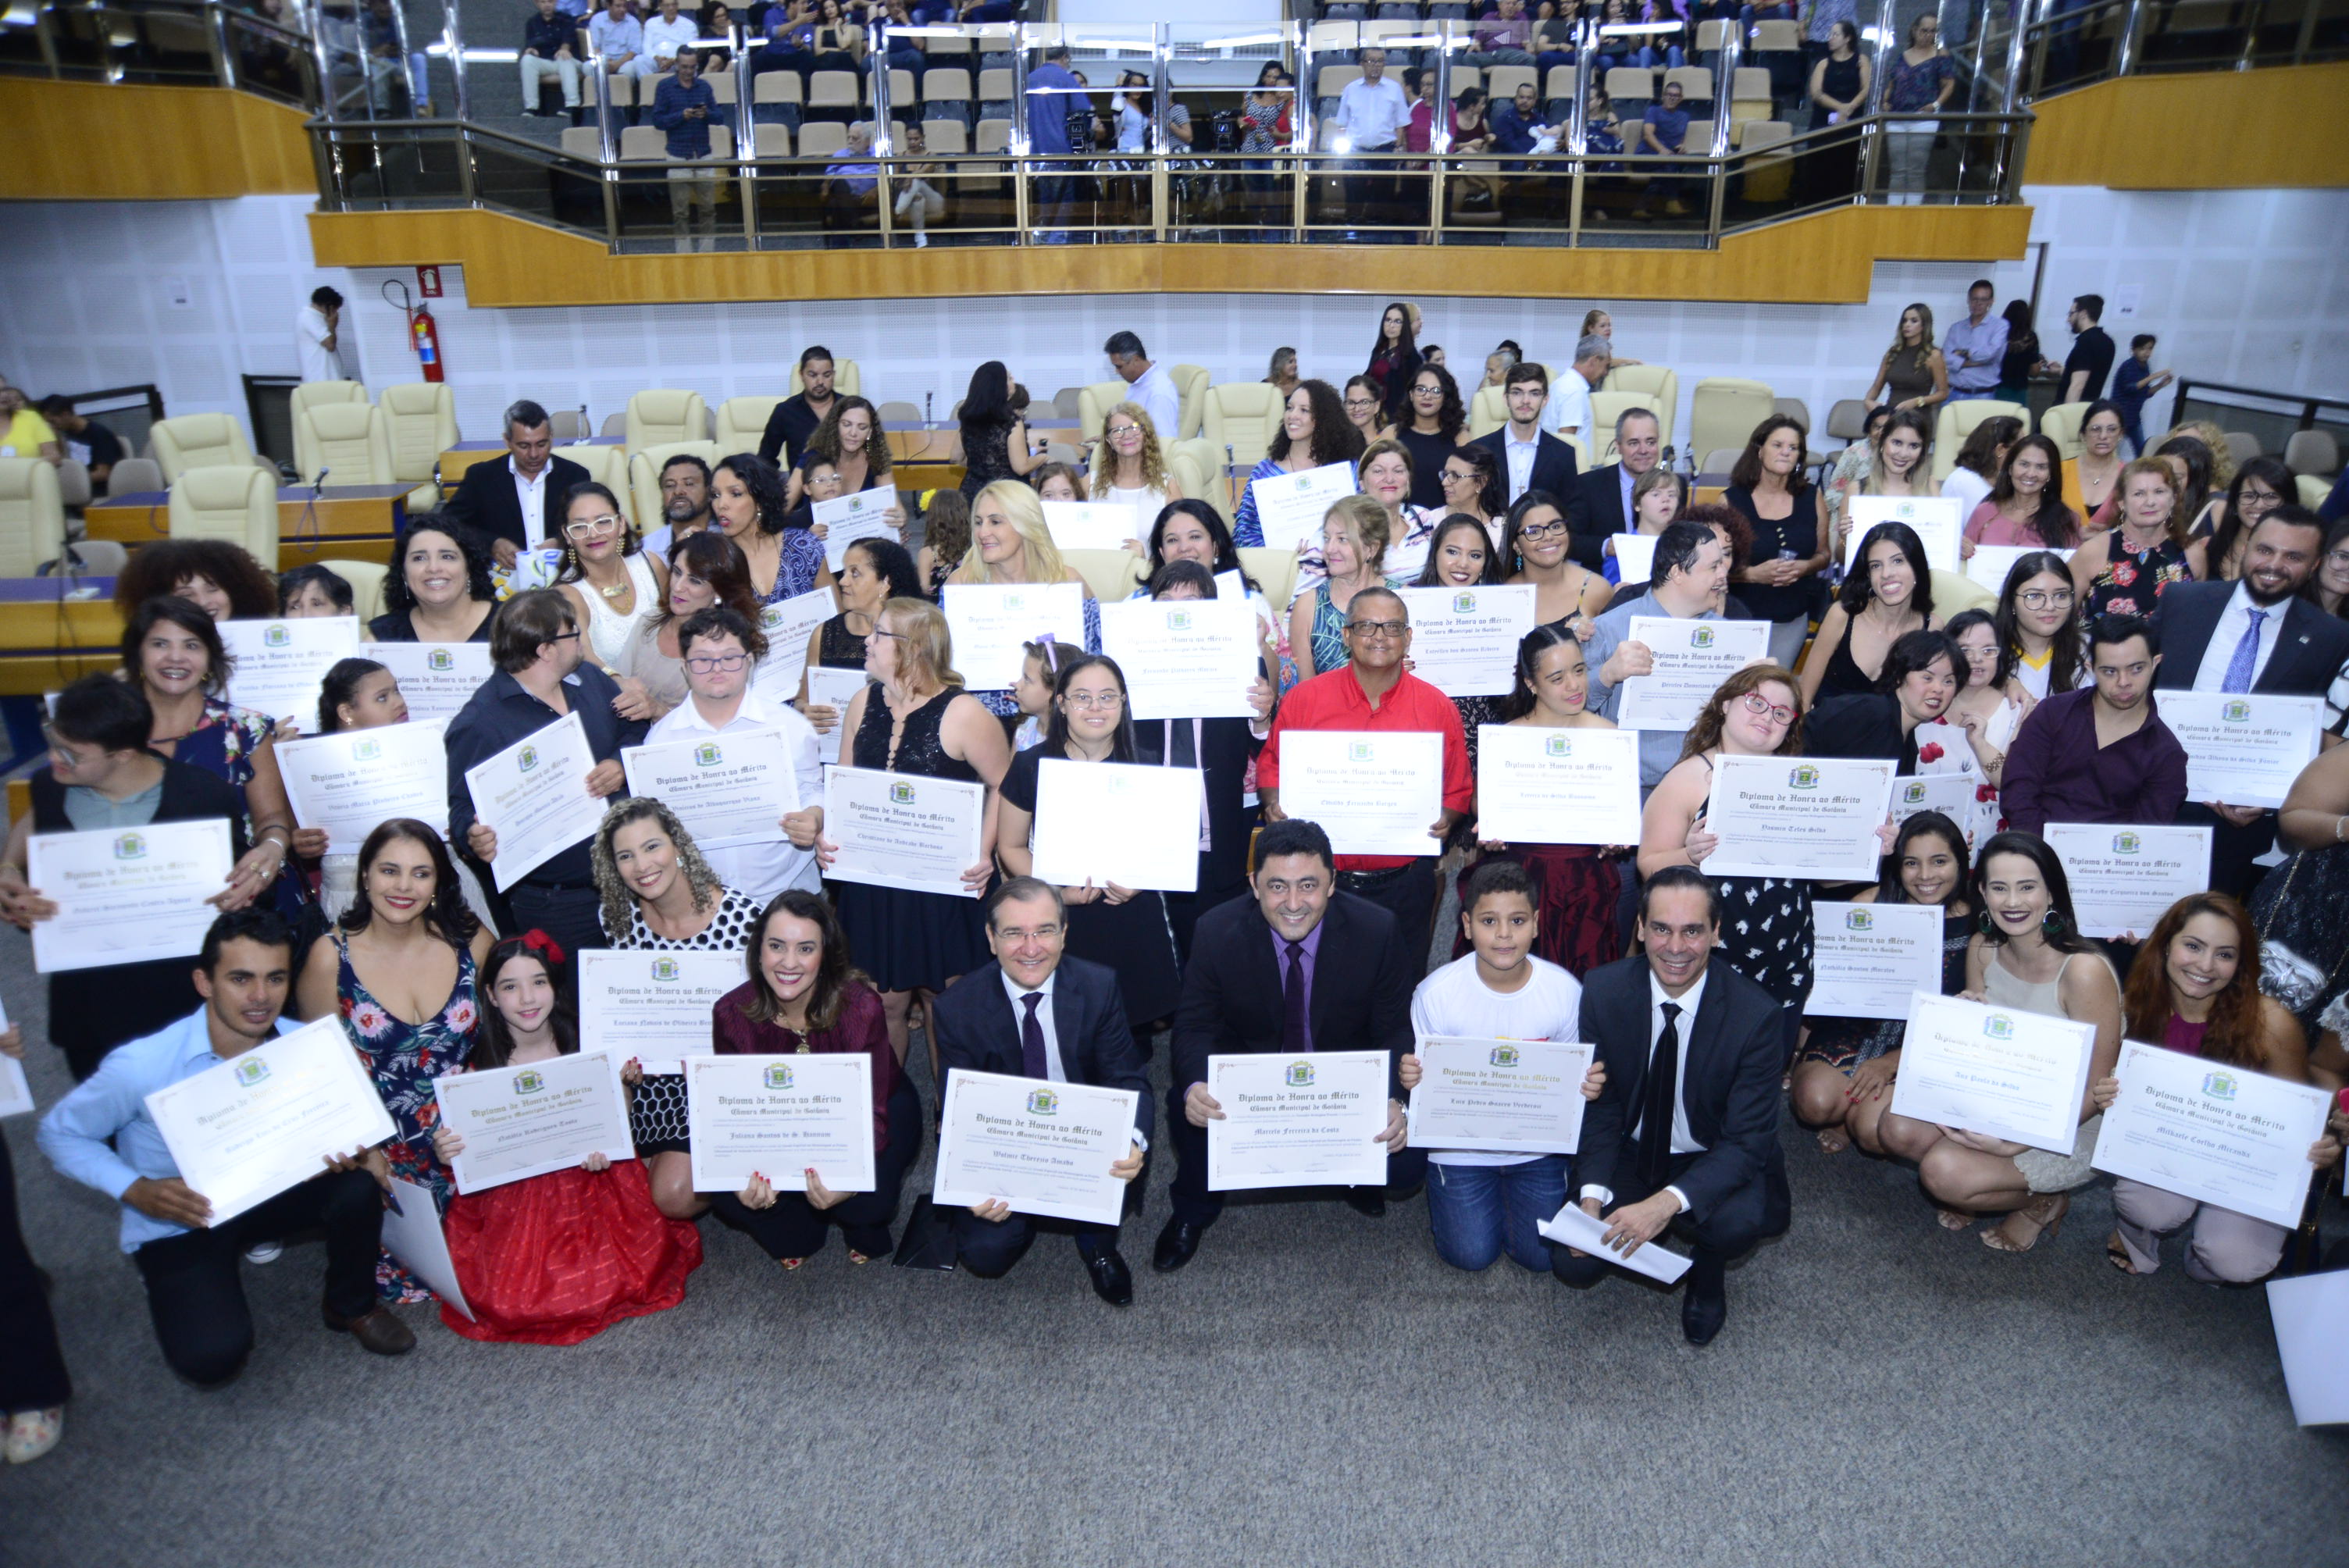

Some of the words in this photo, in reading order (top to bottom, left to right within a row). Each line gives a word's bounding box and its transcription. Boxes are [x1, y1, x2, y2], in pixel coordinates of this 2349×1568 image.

[1652, 650, 1679, 660] Diploma
[1691, 652, 1712, 661] Honra
[1723, 653, 1745, 661] Mérito
[2176, 723, 2209, 732] Diploma
[2223, 725, 2248, 734] Honra
[2263, 728, 2291, 736] Mérito
[655, 776, 688, 785] Diploma
[700, 771, 726, 779] Honra
[740, 764, 767, 774] Mérito
[694, 780, 725, 789] Municipal
[734, 775, 757, 784] Goiânia
[1739, 791, 1773, 801] Diploma
[1789, 793, 1816, 803] Honra
[1831, 795, 1860, 804] Mérito
[849, 801, 879, 813] Diploma
[881, 806, 890, 814] de
[892, 807, 915, 818] Honra
[929, 813, 955, 823] Mérito
[859, 813, 882, 822] Câmara
[883, 817, 911, 826] Municipal
[921, 821, 943, 831] Goiânia
[2068, 857, 2100, 865] Diploma
[2114, 858, 2139, 867] Honra
[2153, 859, 2181, 868] Mérito
[1813, 933, 1836, 942] ploma
[1837, 934, 1846, 943] de
[1848, 935, 1873, 943] Honra
[1887, 936, 1915, 945] Mérito
[608, 986, 641, 995] Diploma
[643, 986, 652, 995] de
[654, 986, 680, 995] Honra
[694, 986, 722, 995] Mérito
[1442, 1067, 1476, 1077] Diploma
[1491, 1071, 1517, 1080] Honra
[1531, 1074, 1560, 1082] Mérito
[1480, 1080, 1512, 1089] Municipal
[1522, 1082, 1547, 1091] Goiânia
[471, 1106, 507, 1117] Diploma
[508, 1102, 519, 1110] de
[521, 1096, 548, 1107] Honra
[563, 1086, 592, 1098] Mérito
[718, 1096, 753, 1106] Diploma
[756, 1096, 765, 1105] de
[768, 1095, 796, 1104] Honra
[811, 1094, 842, 1103] Mérito
[1238, 1093, 1273, 1103] Diploma
[1276, 1092, 1285, 1101] de
[1289, 1092, 1315, 1101] Honra
[1330, 1091, 1359, 1099] Mérito
[2145, 1085, 2183, 1103] Diploma
[2187, 1097, 2198, 1107] de
[2201, 1100, 2232, 1117] Honra
[2234, 1112, 2247, 1121] ao
[2250, 1115, 2285, 1131] Mérito
[975, 1113, 1011, 1126] Diploma
[1014, 1118, 1025, 1128] de
[1028, 1119, 1056, 1131] Honra
[1071, 1125, 1102, 1136] Mérito
[2155, 1100, 2185, 1115] Câmara
[2187, 1110, 2225, 1125] Municipal
[2226, 1120, 2235, 1128] de
[2237, 1124, 2267, 1138] Goiânia
[729, 1131, 755, 1140] Juliana
[986, 1126, 1014, 1136] Câmara
[1016, 1130, 1050, 1141] Municipal
[1061, 1135, 1088, 1146] Goiânia
[1281, 1127, 1310, 1135] Ferreira
[2190, 1135, 2215, 1148] Coelho
[2216, 1143, 2251, 1158] Miranda
[1050, 1156, 1074, 1166] Amado
